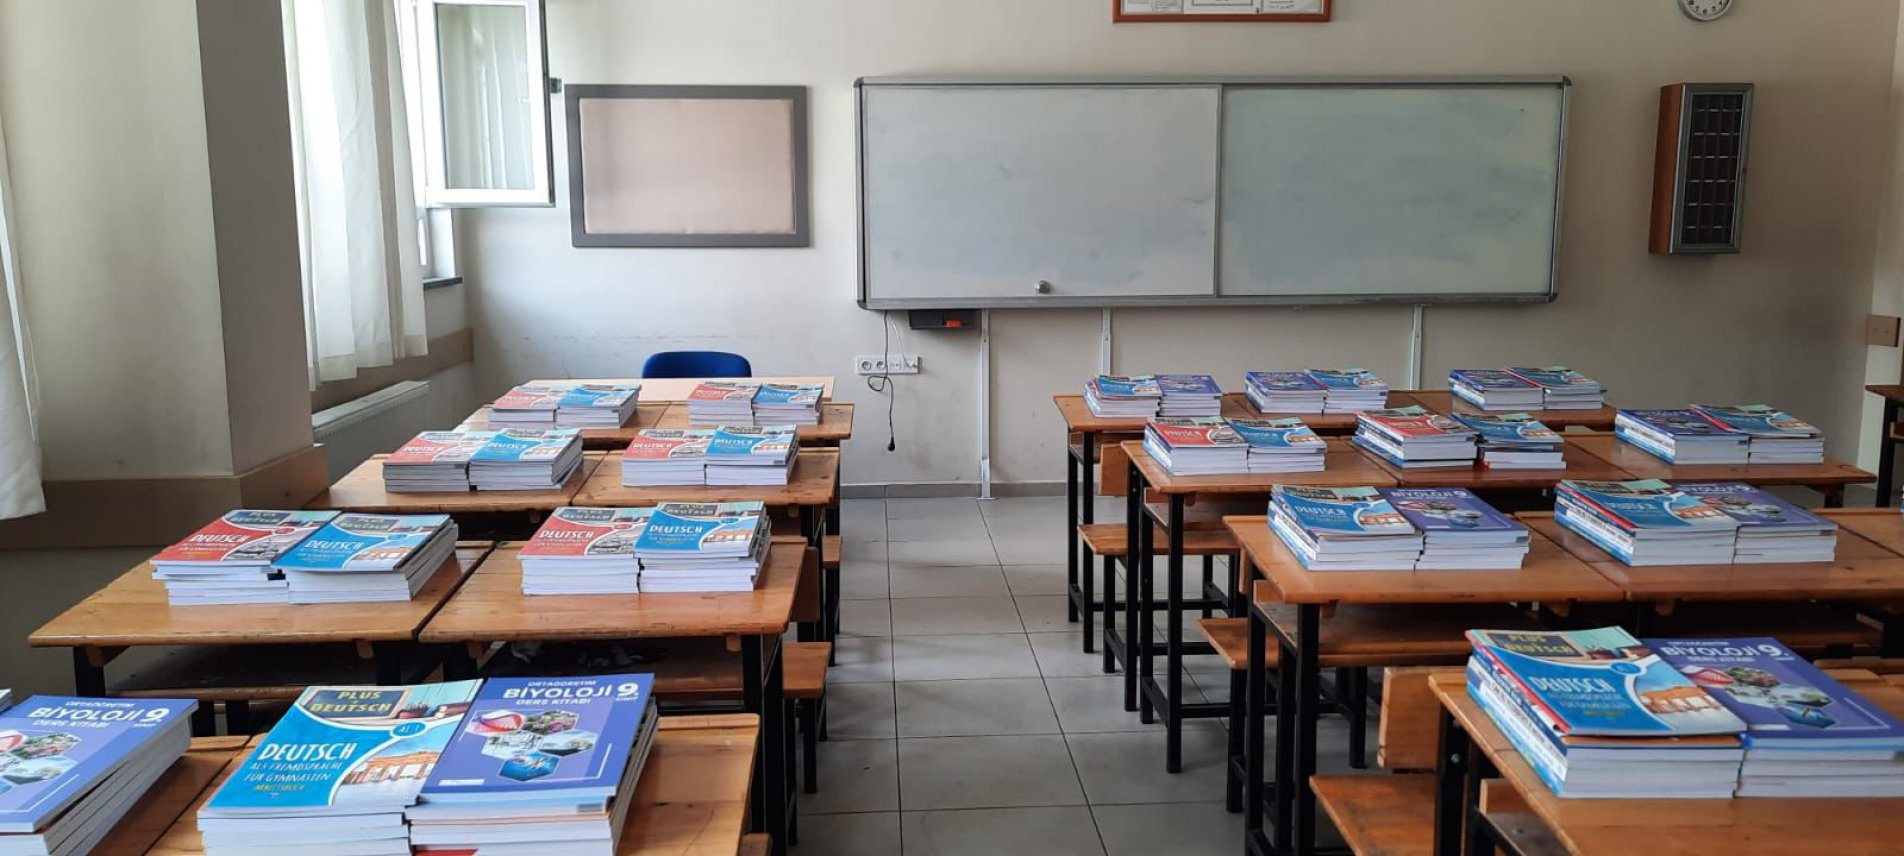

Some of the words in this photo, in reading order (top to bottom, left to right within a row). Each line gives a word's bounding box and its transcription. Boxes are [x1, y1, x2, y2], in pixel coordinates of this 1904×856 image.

[648, 525, 703, 533] DEUTSCH
[189, 534, 250, 543] DEUTSCH
[540, 530, 596, 539] DEUTSCH
[303, 540, 364, 549] DEUTSCH
[1528, 676, 1617, 693] DEUTSCH
[337, 691, 382, 700] PLUS
[502, 684, 614, 699] BİYOLOJİ
[308, 703, 392, 713] DEUTSCH
[27, 706, 145, 721] BİYOLOJİ
[257, 742, 358, 761] DEUTSCH
